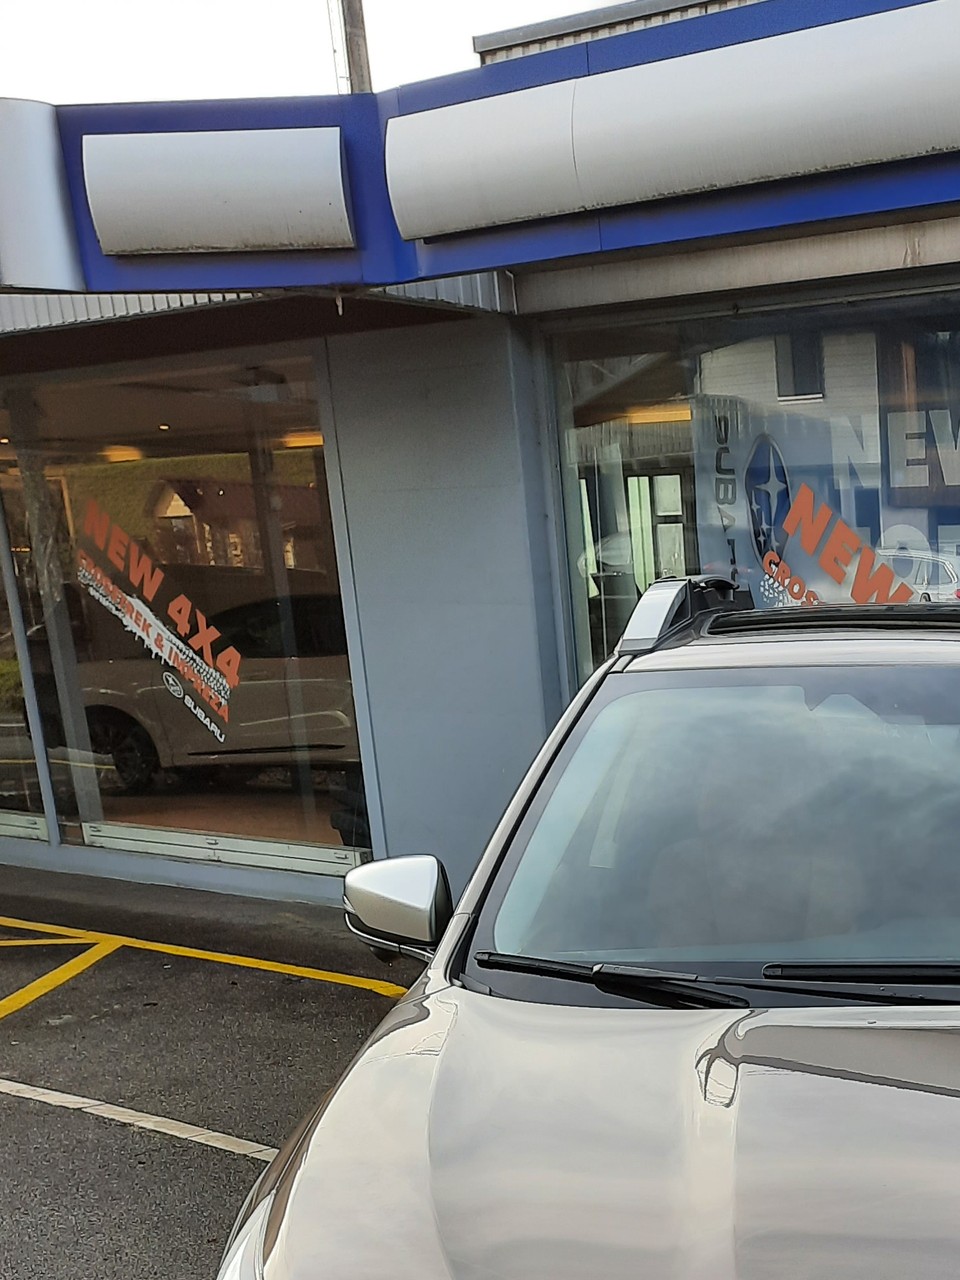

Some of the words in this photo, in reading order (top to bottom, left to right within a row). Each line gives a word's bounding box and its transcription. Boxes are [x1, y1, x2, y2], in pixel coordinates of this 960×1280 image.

[763, 551, 825, 606] CROS
[783, 482, 914, 604] NEW
[84, 499, 164, 601] NEW
[168, 594, 241, 689] 4X4
[183, 694, 226, 743] SUBARU
